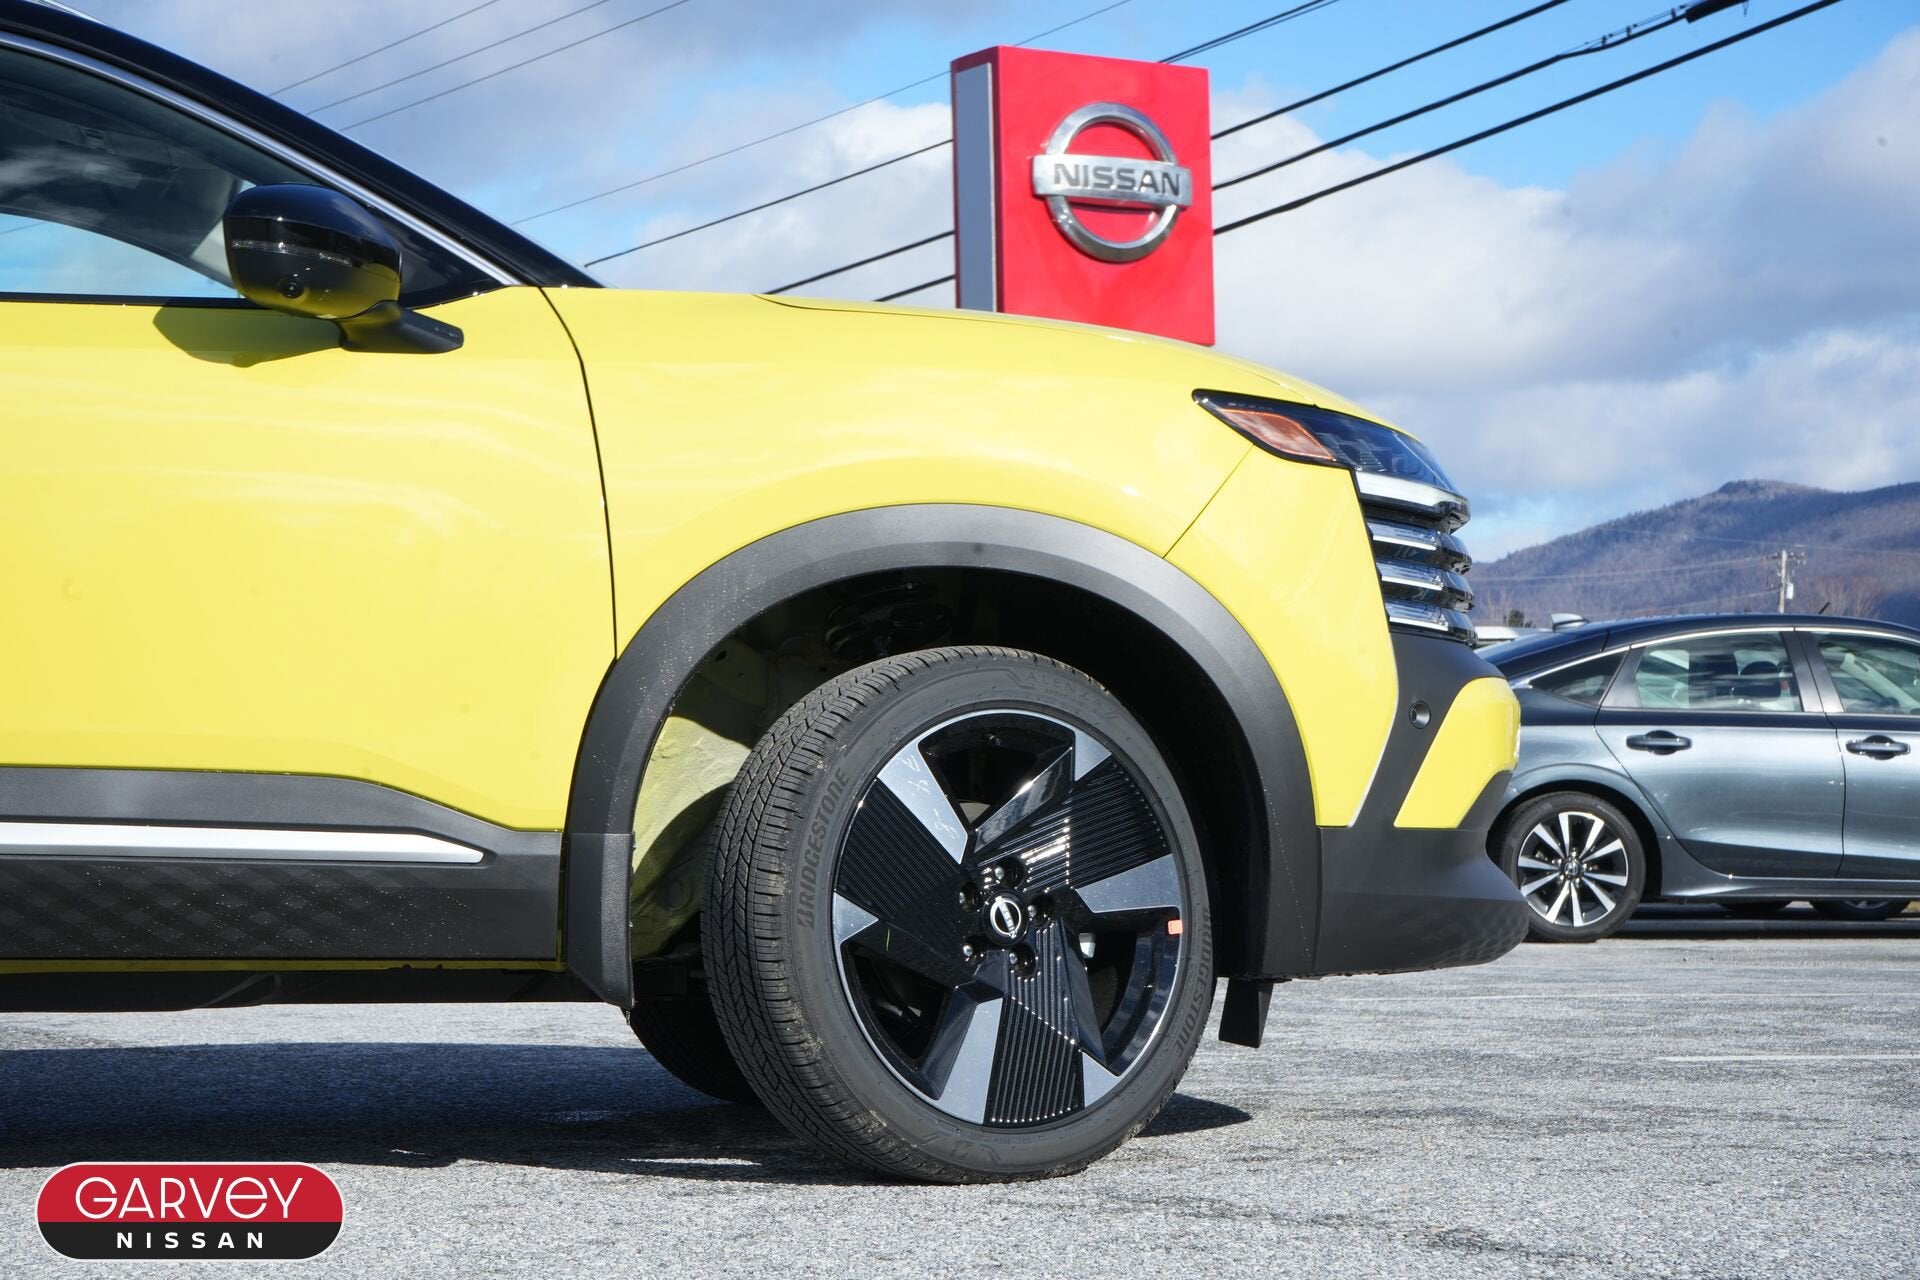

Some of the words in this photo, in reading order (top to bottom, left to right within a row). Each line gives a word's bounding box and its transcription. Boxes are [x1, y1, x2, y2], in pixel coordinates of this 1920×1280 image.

[1053, 163, 1181, 197] NISSAN
[796, 768, 850, 931] BRIDGESTONE
[1174, 907, 1212, 1056] BRIDGESTONE
